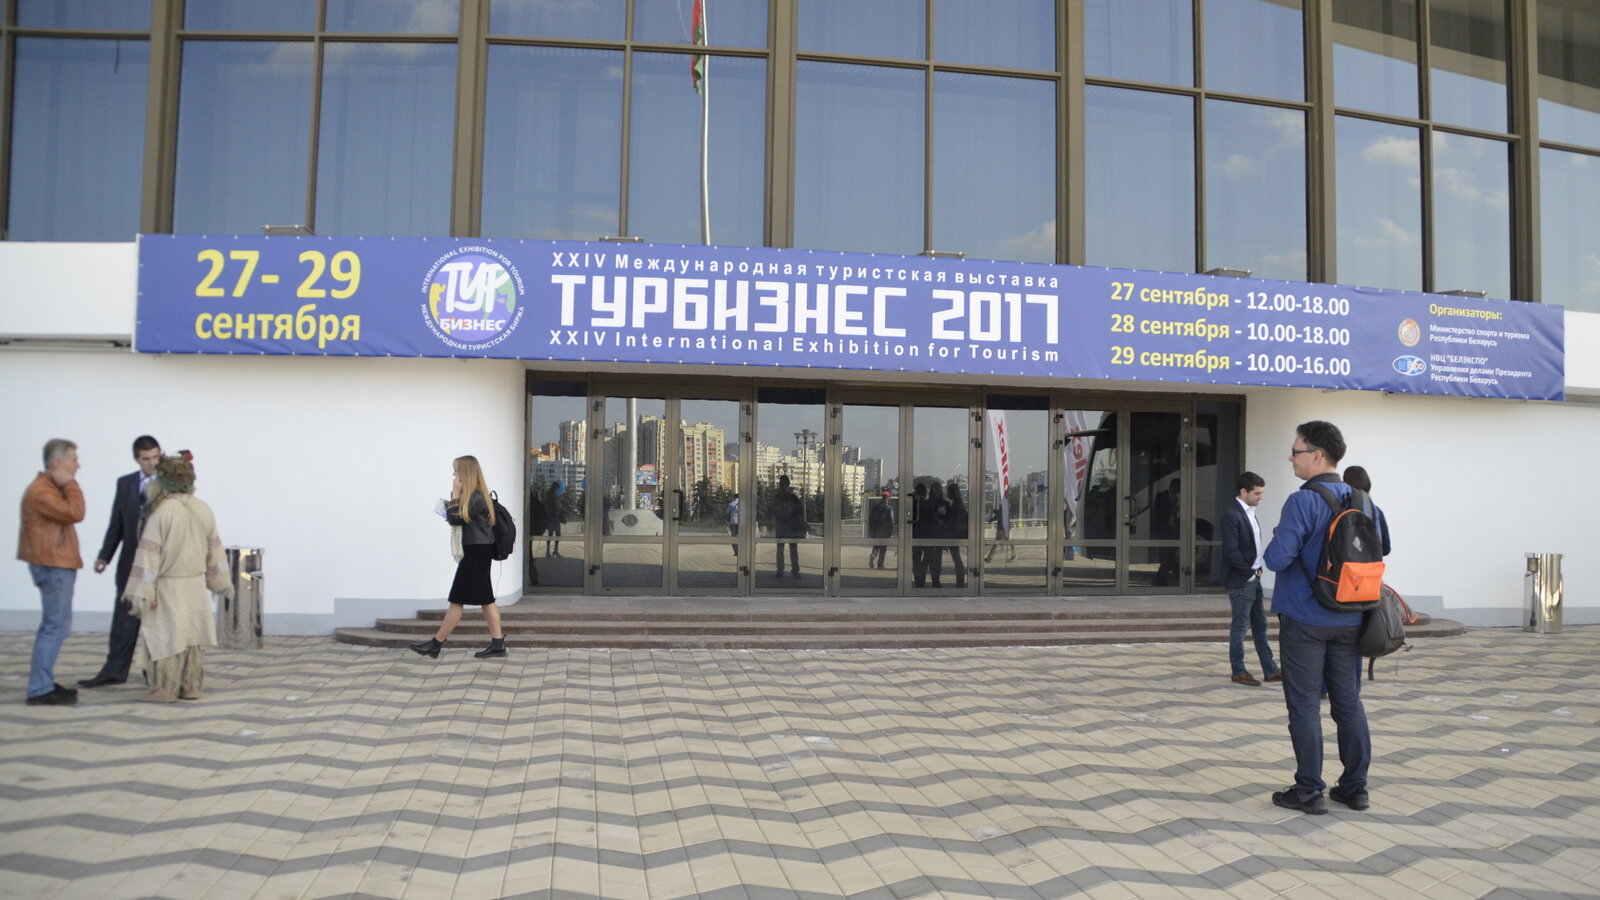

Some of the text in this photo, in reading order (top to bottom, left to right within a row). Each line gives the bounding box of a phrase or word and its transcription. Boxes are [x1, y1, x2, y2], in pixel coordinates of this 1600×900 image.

[296, 250, 361, 299] 29
[421, 246, 525, 295] INTERNATIONAL EXHIBITION FOR TOURISM
[552, 252, 1058, 288] XXIV Международная туристская выставка
[551, 274, 1059, 344] ТУРБИЗНЕС 2017
[1110, 282, 1135, 301] 27
[1140, 287, 1230, 310] сентября
[1247, 292, 1350, 316] 12.00-18.00
[1430, 303, 1503, 321] Организаторы:
[194, 304, 361, 348] сентября
[421, 304, 525, 351] МЕЖДУНАРОДНАЯ ТУРИСТСКАЯ БИРЖА
[440, 318, 506, 331] БИЗНЕС
[1110, 314, 1135, 333] 28
[1140, 318, 1230, 341] сентября
[1247, 322, 1350, 346] 10.00-18.00
[1430, 324, 1476, 335] Министерство
[1476, 329, 1498, 338] спорта
[1504, 331, 1530, 340] туризма
[550, 330, 1059, 362] XXIV International Exhibition for Tourism
[1430, 334, 1498, 348] Республики Беларусь
[1110, 346, 1135, 365] 29
[1140, 350, 1230, 373] сентября
[1247, 353, 1351, 376] 10.00-16.00
[1431, 354, 1446, 364] НВЦ
[1431, 363, 1469, 373] Управления
[1470, 367, 1495, 375] делами
[1495, 368, 1532, 378] Президента
[1431, 373, 1499, 386] Республики Беларусь
